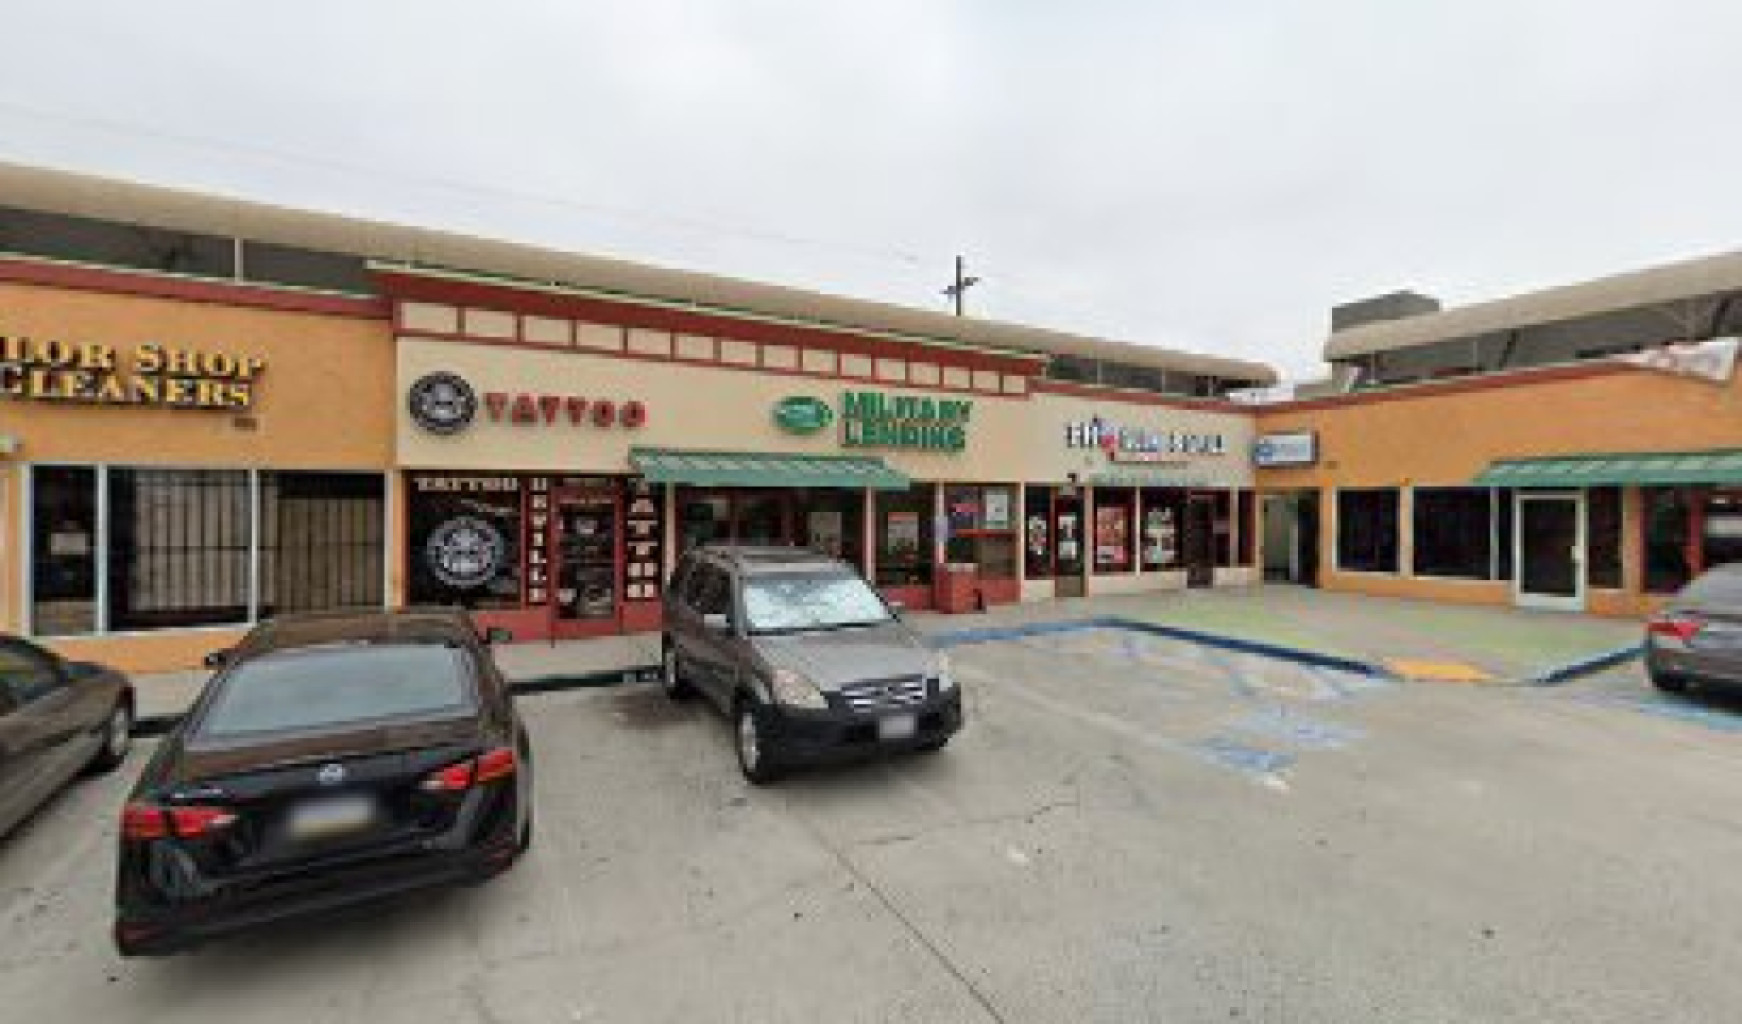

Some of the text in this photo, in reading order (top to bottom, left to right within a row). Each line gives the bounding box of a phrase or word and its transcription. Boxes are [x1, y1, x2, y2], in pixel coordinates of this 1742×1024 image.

[135, 343, 266, 379] SHOP
[0, 364, 252, 408] CLEANERS
[484, 392, 648, 428] TATTOO
[840, 391, 973, 421] MILITARY
[840, 420, 967, 451] LENDING
